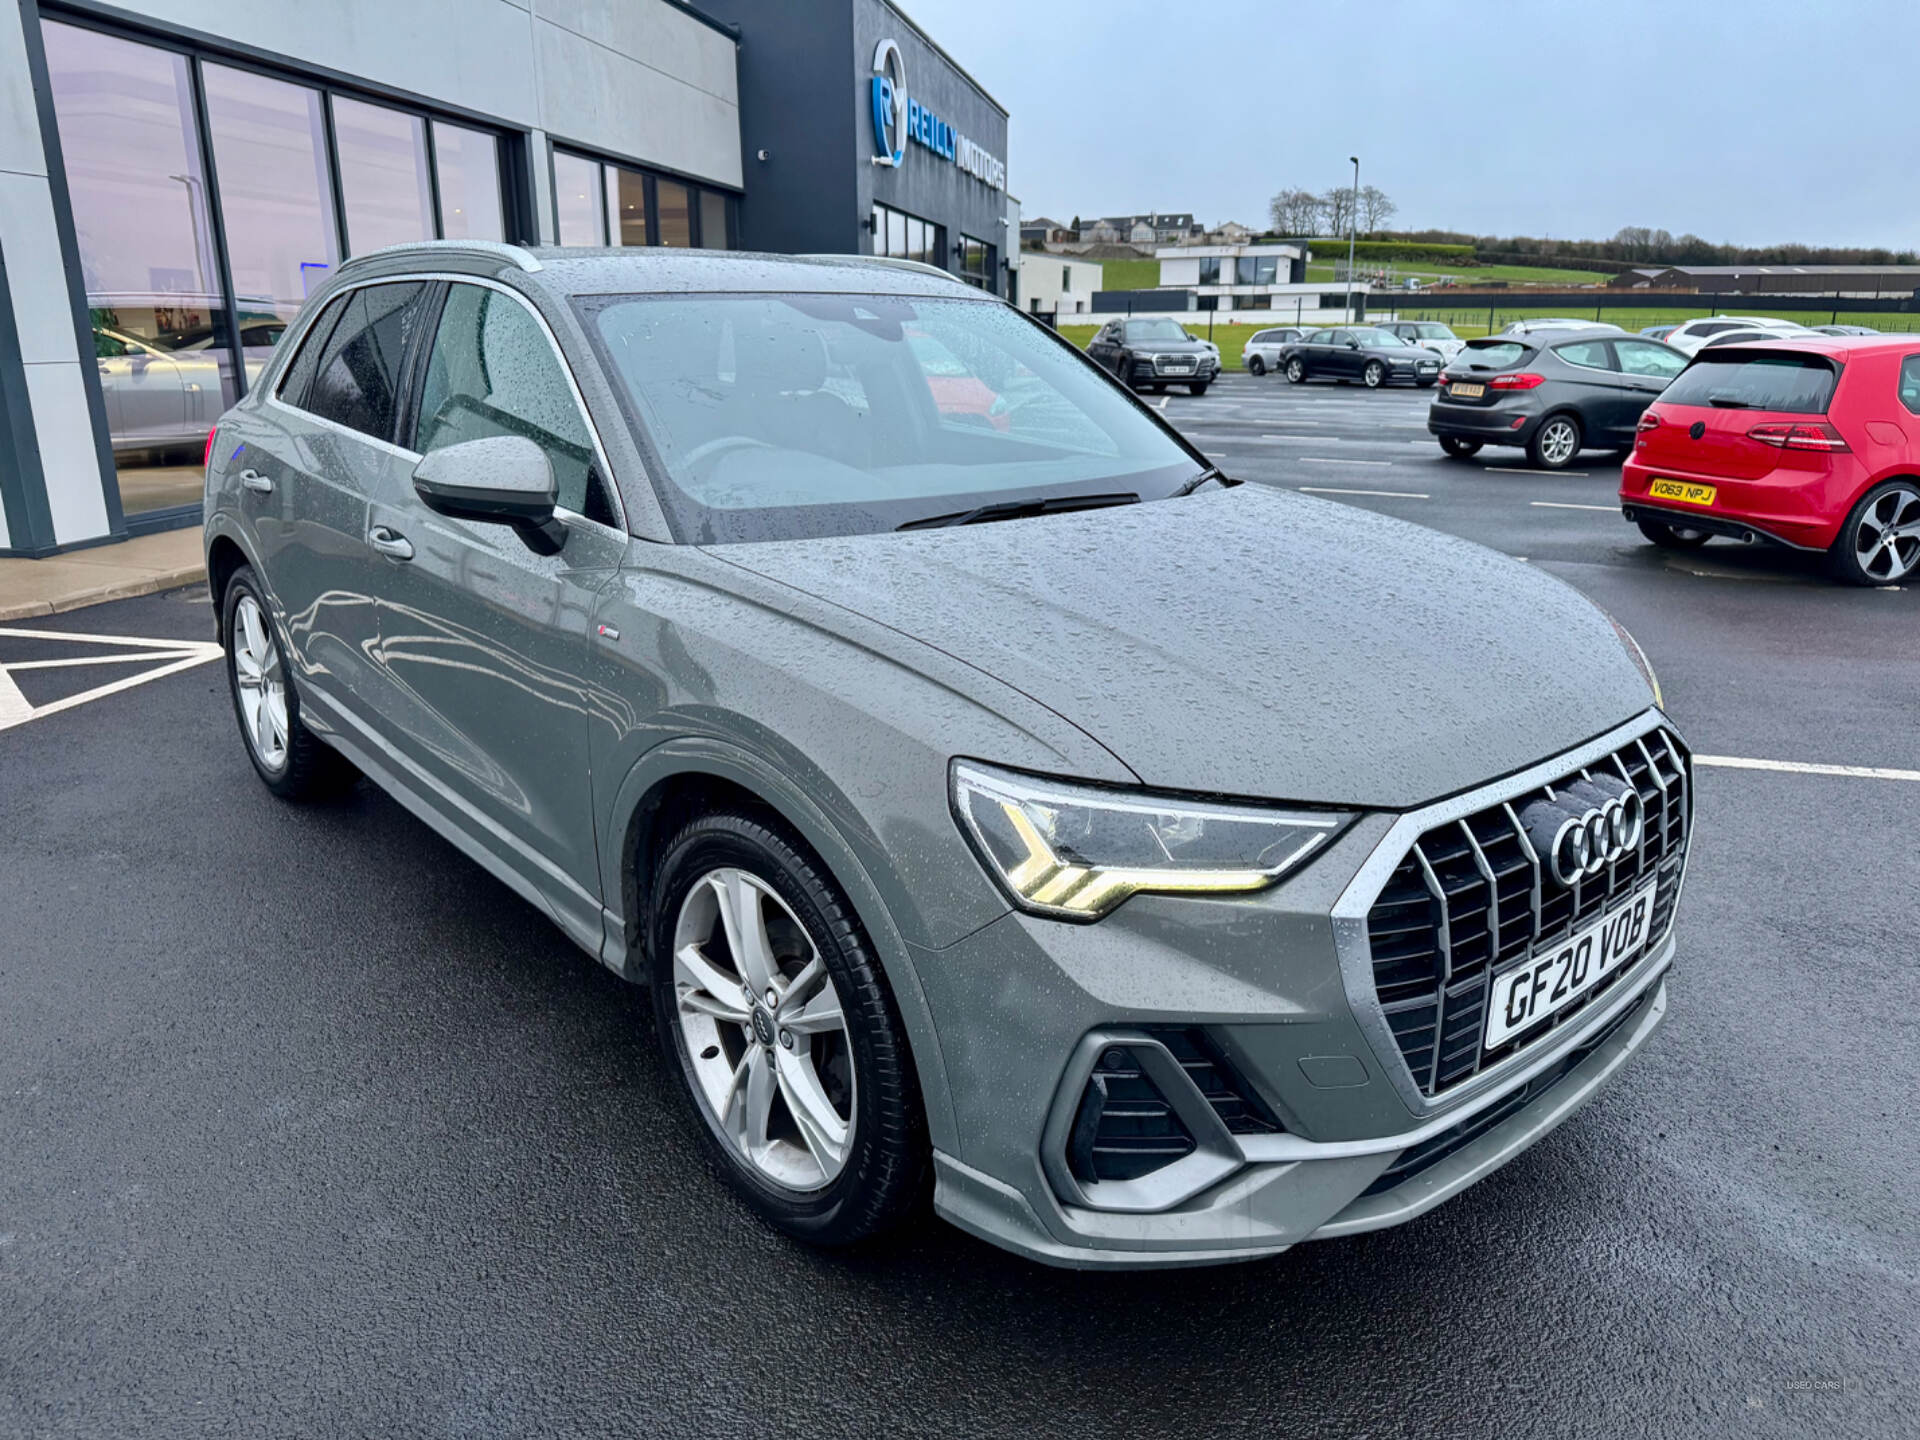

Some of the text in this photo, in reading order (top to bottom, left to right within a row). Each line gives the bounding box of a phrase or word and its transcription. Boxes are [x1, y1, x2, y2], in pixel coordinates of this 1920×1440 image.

[908, 98, 1005, 191] REILLY MOTORS
[1686, 487, 1713, 502] NPJ
[1506, 896, 1647, 1028] GF20 VOB
